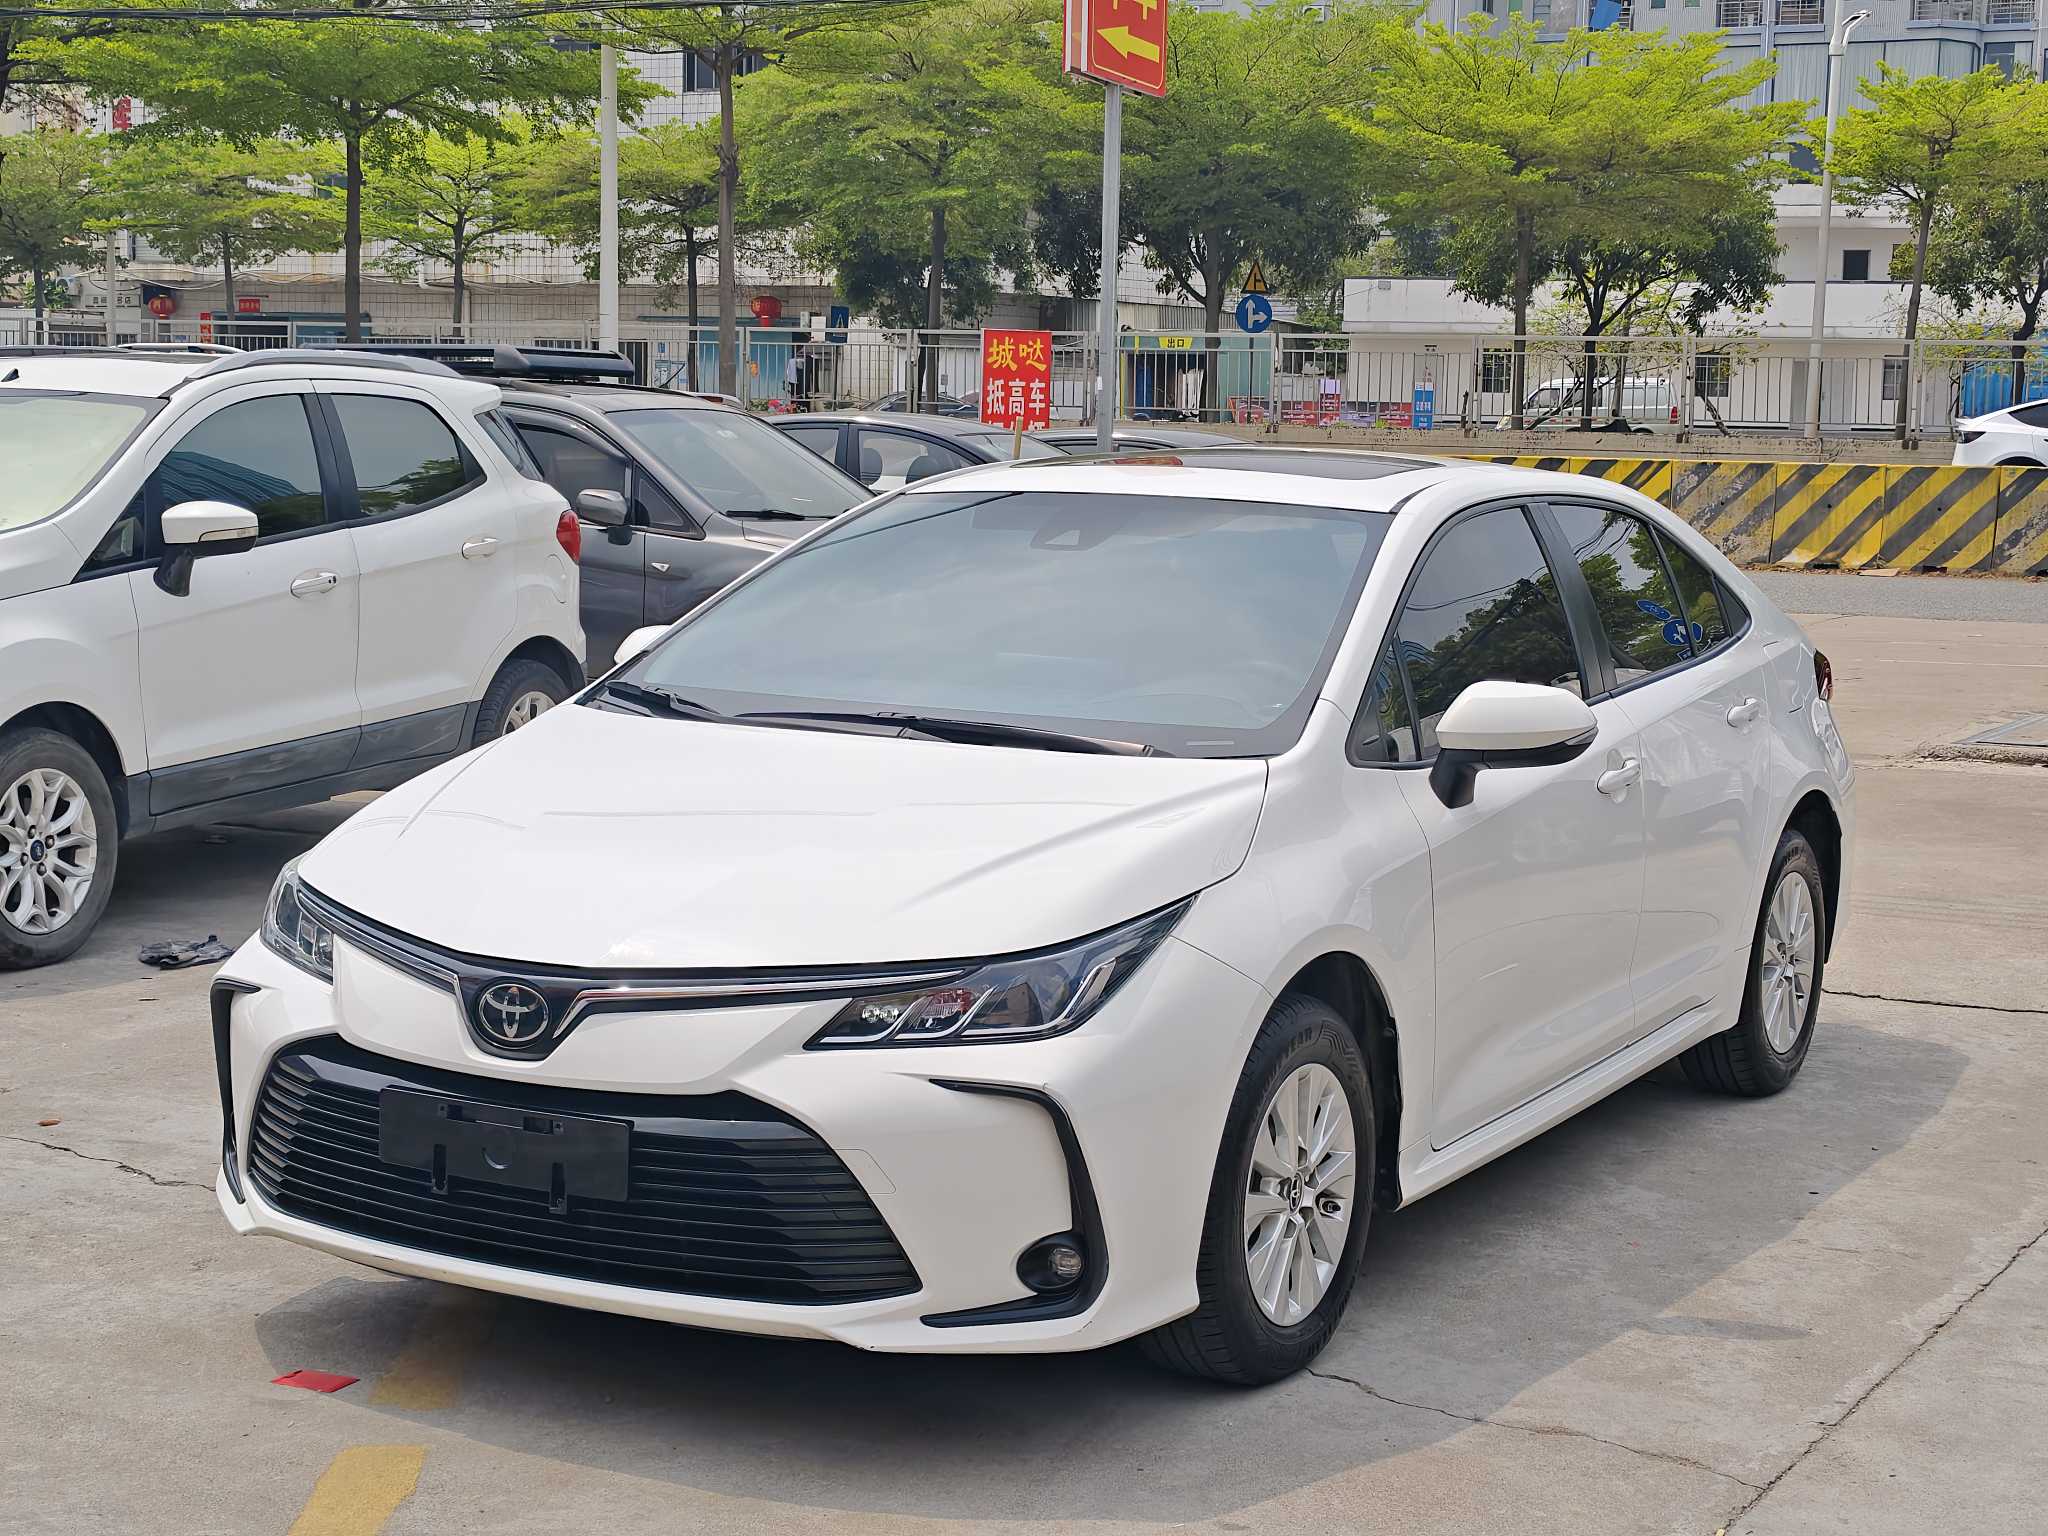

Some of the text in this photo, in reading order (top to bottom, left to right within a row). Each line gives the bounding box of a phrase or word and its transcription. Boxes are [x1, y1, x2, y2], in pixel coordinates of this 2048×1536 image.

[987, 336, 1048, 372] 城哒
[1167, 338, 1185, 348] 出口
[987, 377, 1046, 416] 抵高车
